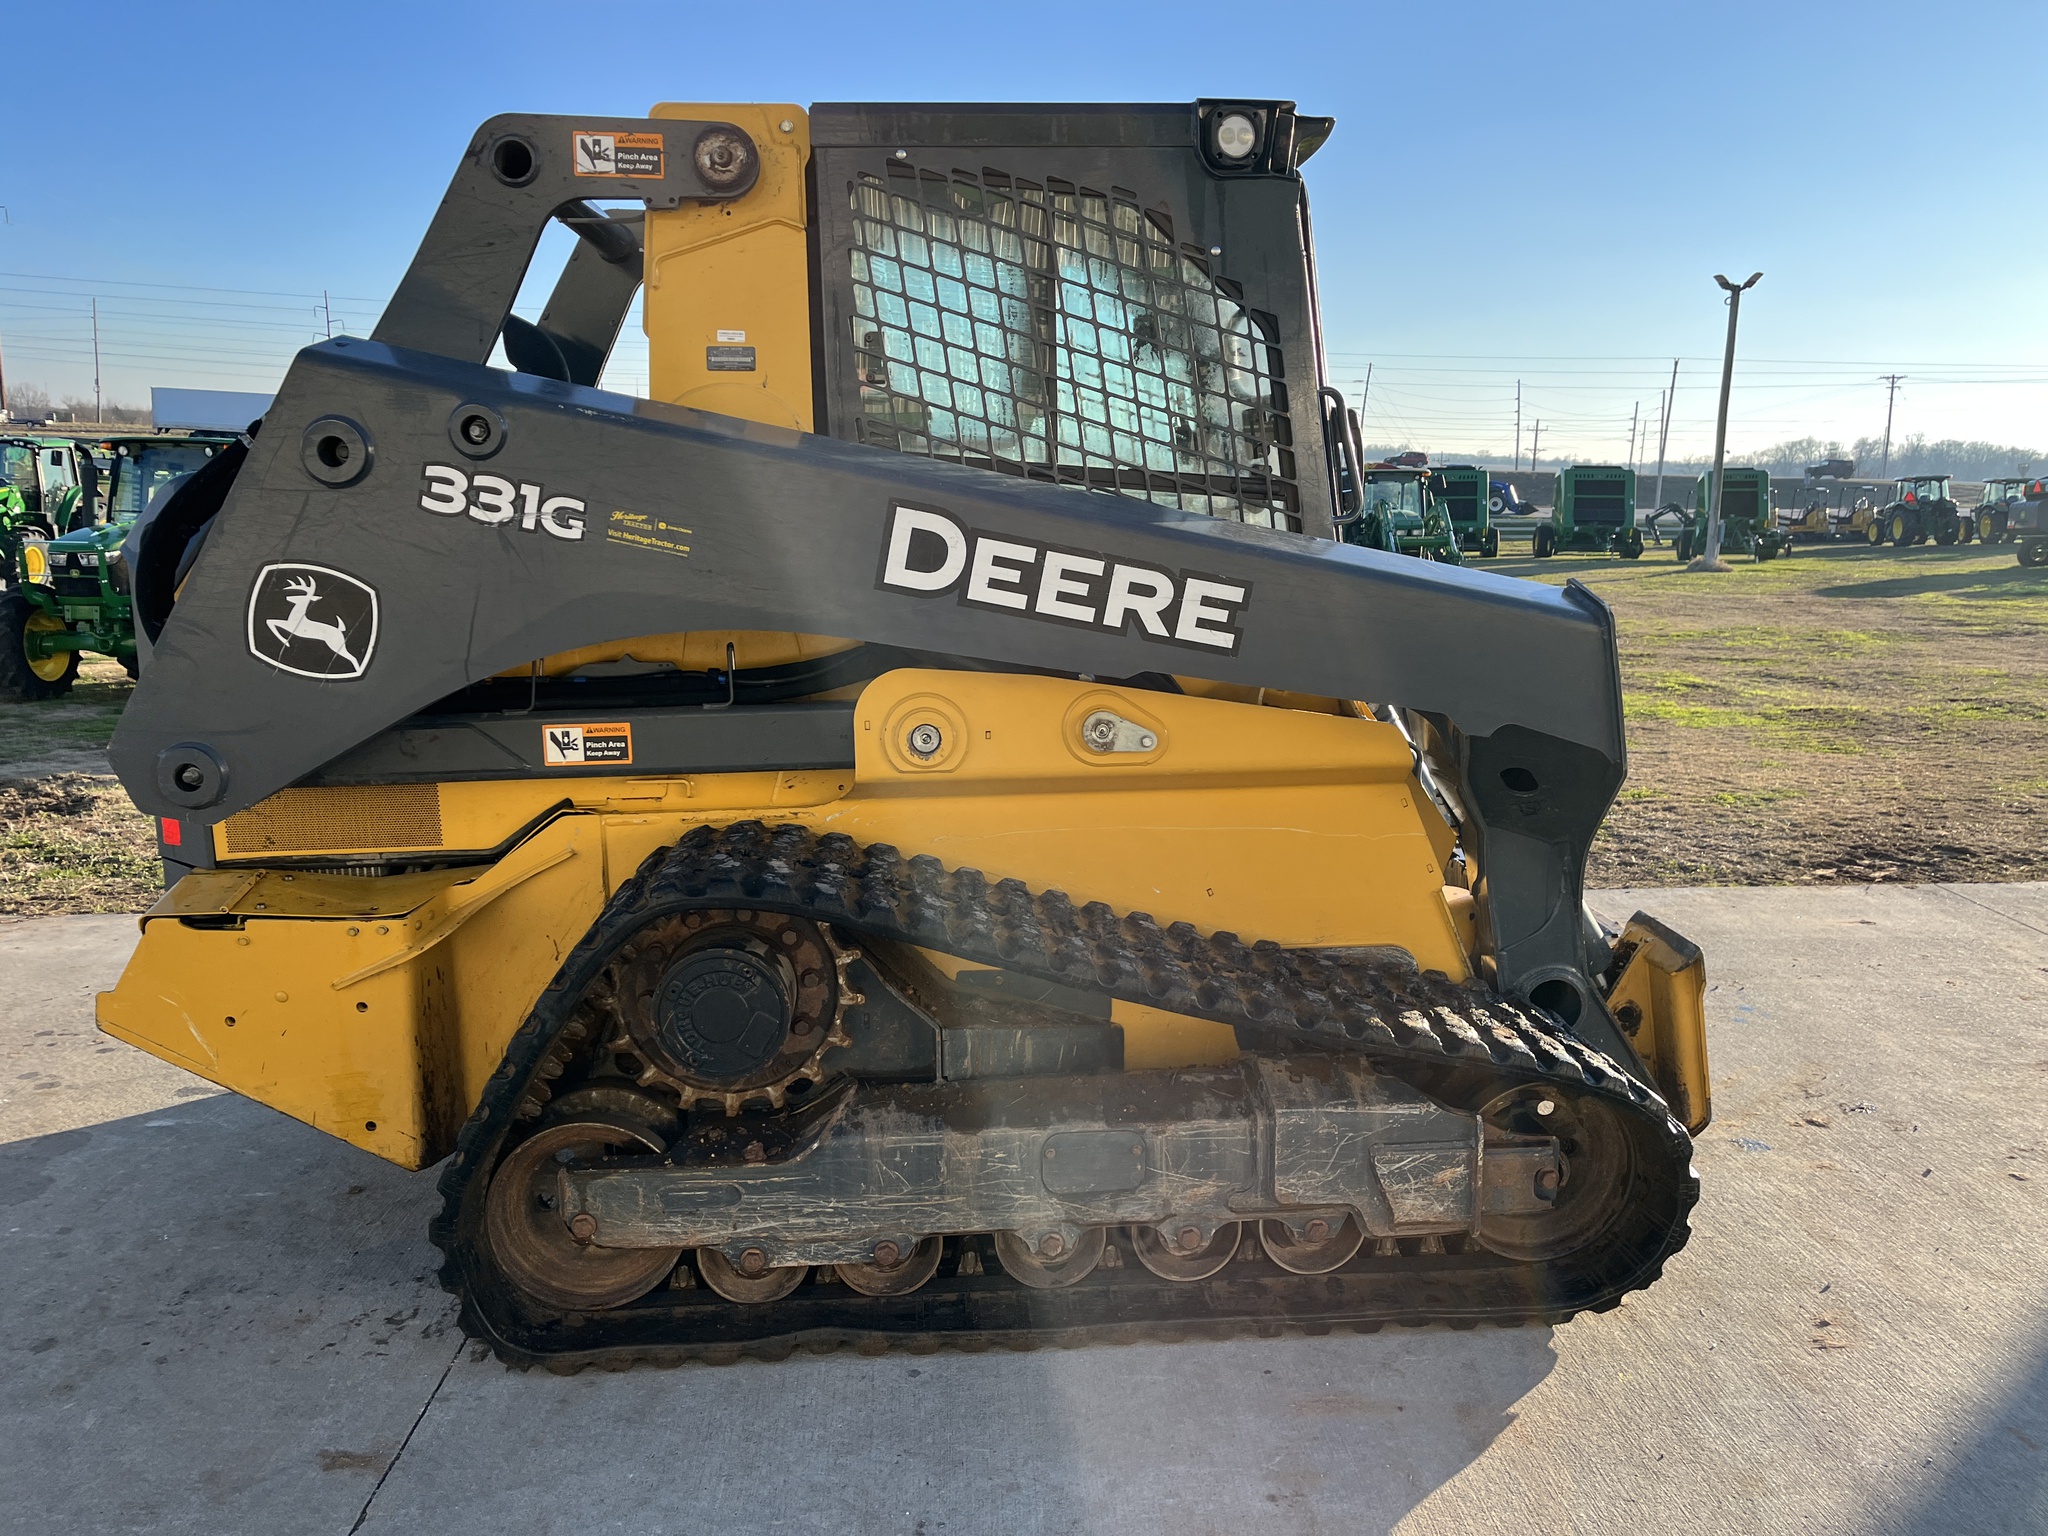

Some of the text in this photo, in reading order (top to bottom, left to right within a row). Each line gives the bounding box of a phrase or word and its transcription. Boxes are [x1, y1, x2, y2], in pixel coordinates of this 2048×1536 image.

[625, 136, 659, 145] WARNING
[617, 152, 659, 161] Pinch Area
[617, 162, 653, 171] Keep Away
[421, 465, 585, 540] 331G
[607, 528, 622, 538] Visit
[623, 533, 690, 552] HeritageTractor.com
[884, 505, 1246, 650] DEERE
[593, 726, 626, 734] WARNING
[586, 740, 626, 749] Pinch Area
[604, 749, 621, 757] Away
